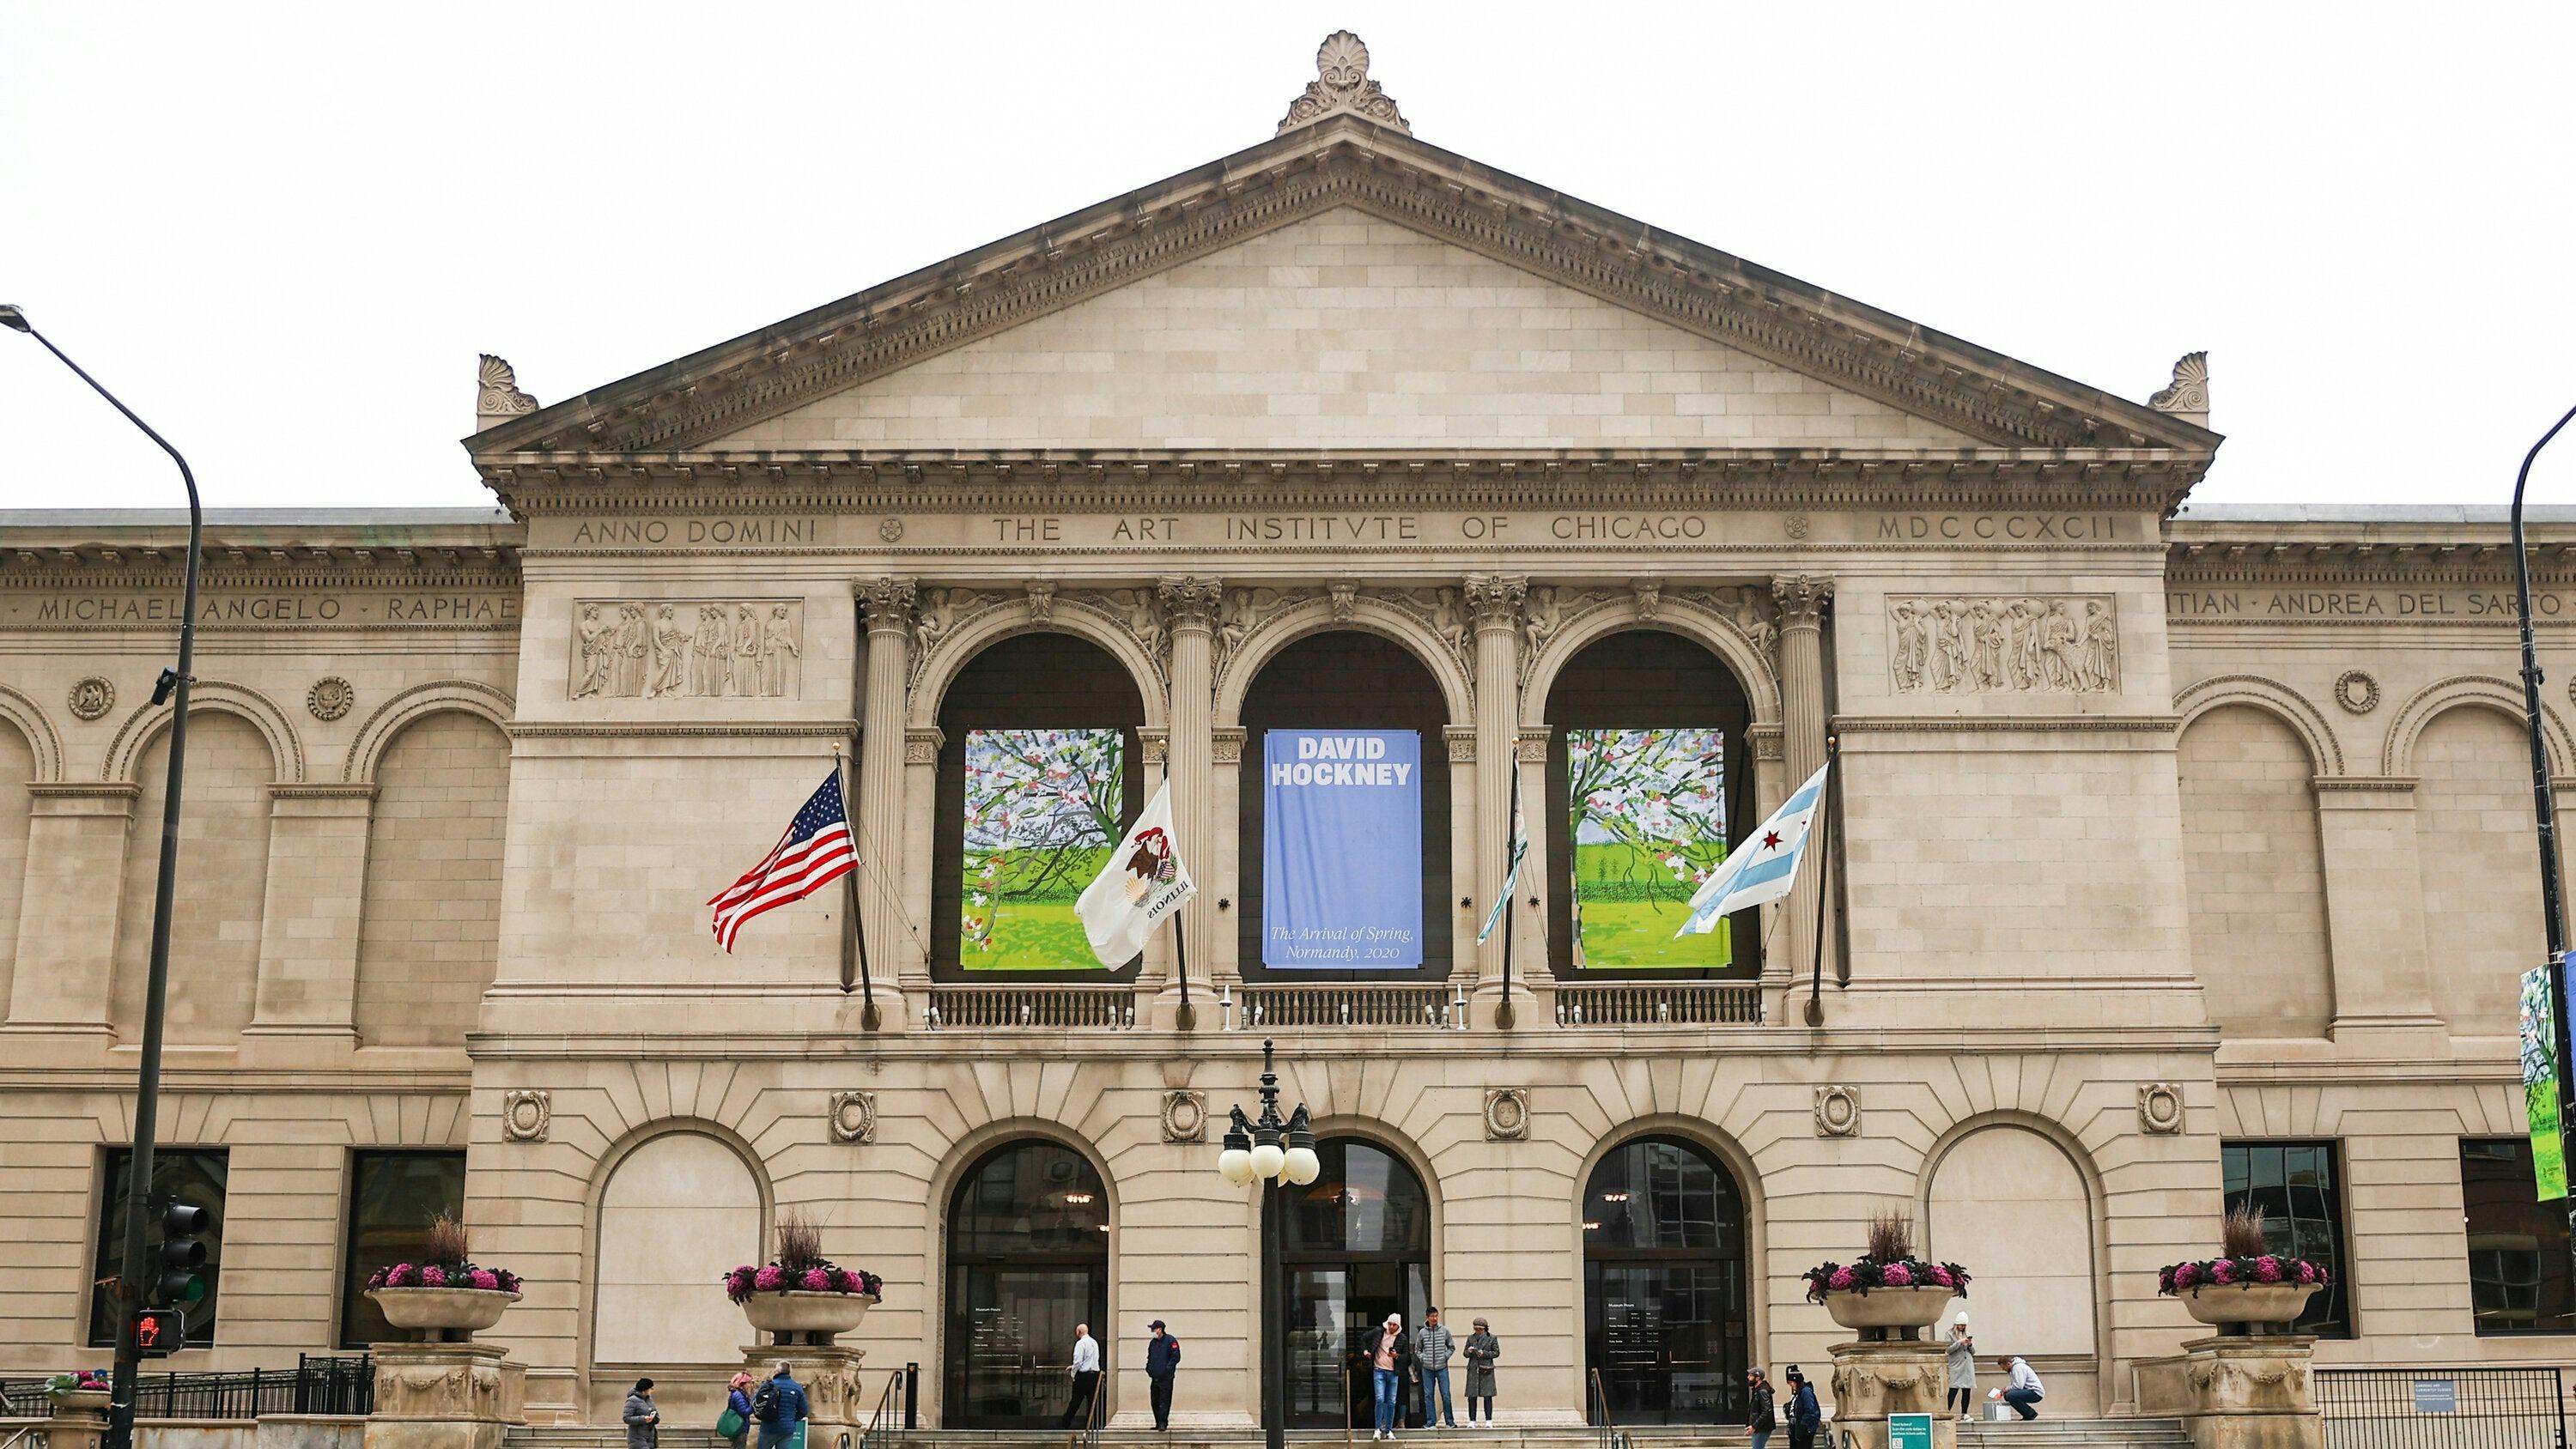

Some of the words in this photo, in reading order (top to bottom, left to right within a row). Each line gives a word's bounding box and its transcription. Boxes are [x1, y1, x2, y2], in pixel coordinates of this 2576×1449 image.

[573, 520, 669, 543] ANNO
[688, 520, 815, 543] DOMINI
[993, 518, 1061, 541] THE
[1111, 518, 1179, 541] ART
[1227, 517, 1418, 539] INSTITVTE
[1462, 517, 1508, 539] OF
[1552, 516, 1705, 539] CHICAGO
[1876, 516, 2114, 539] MDCCCXCII
[38, 599, 185, 620] MICHAEL
[202, 598, 341, 620] ANGELO
[387, 598, 517, 619] RAPHAE
[2166, 592, 2239, 614] ITIAN
[2267, 593, 2384, 615] ANDREA
[2398, 594, 2456, 615] DEL
[1298, 737, 1386, 760] DAVID
[1272, 762, 1412, 786] HOCKNEY
[1271, 926, 1296, 940] The
[1299, 926, 1347, 940] Arrival
[1351, 926, 1365, 943] of
[1366, 926, 1414, 943] Spring,
[1285, 945, 1359, 961] Normandy,
[1364, 948, 1400, 959] 2020
